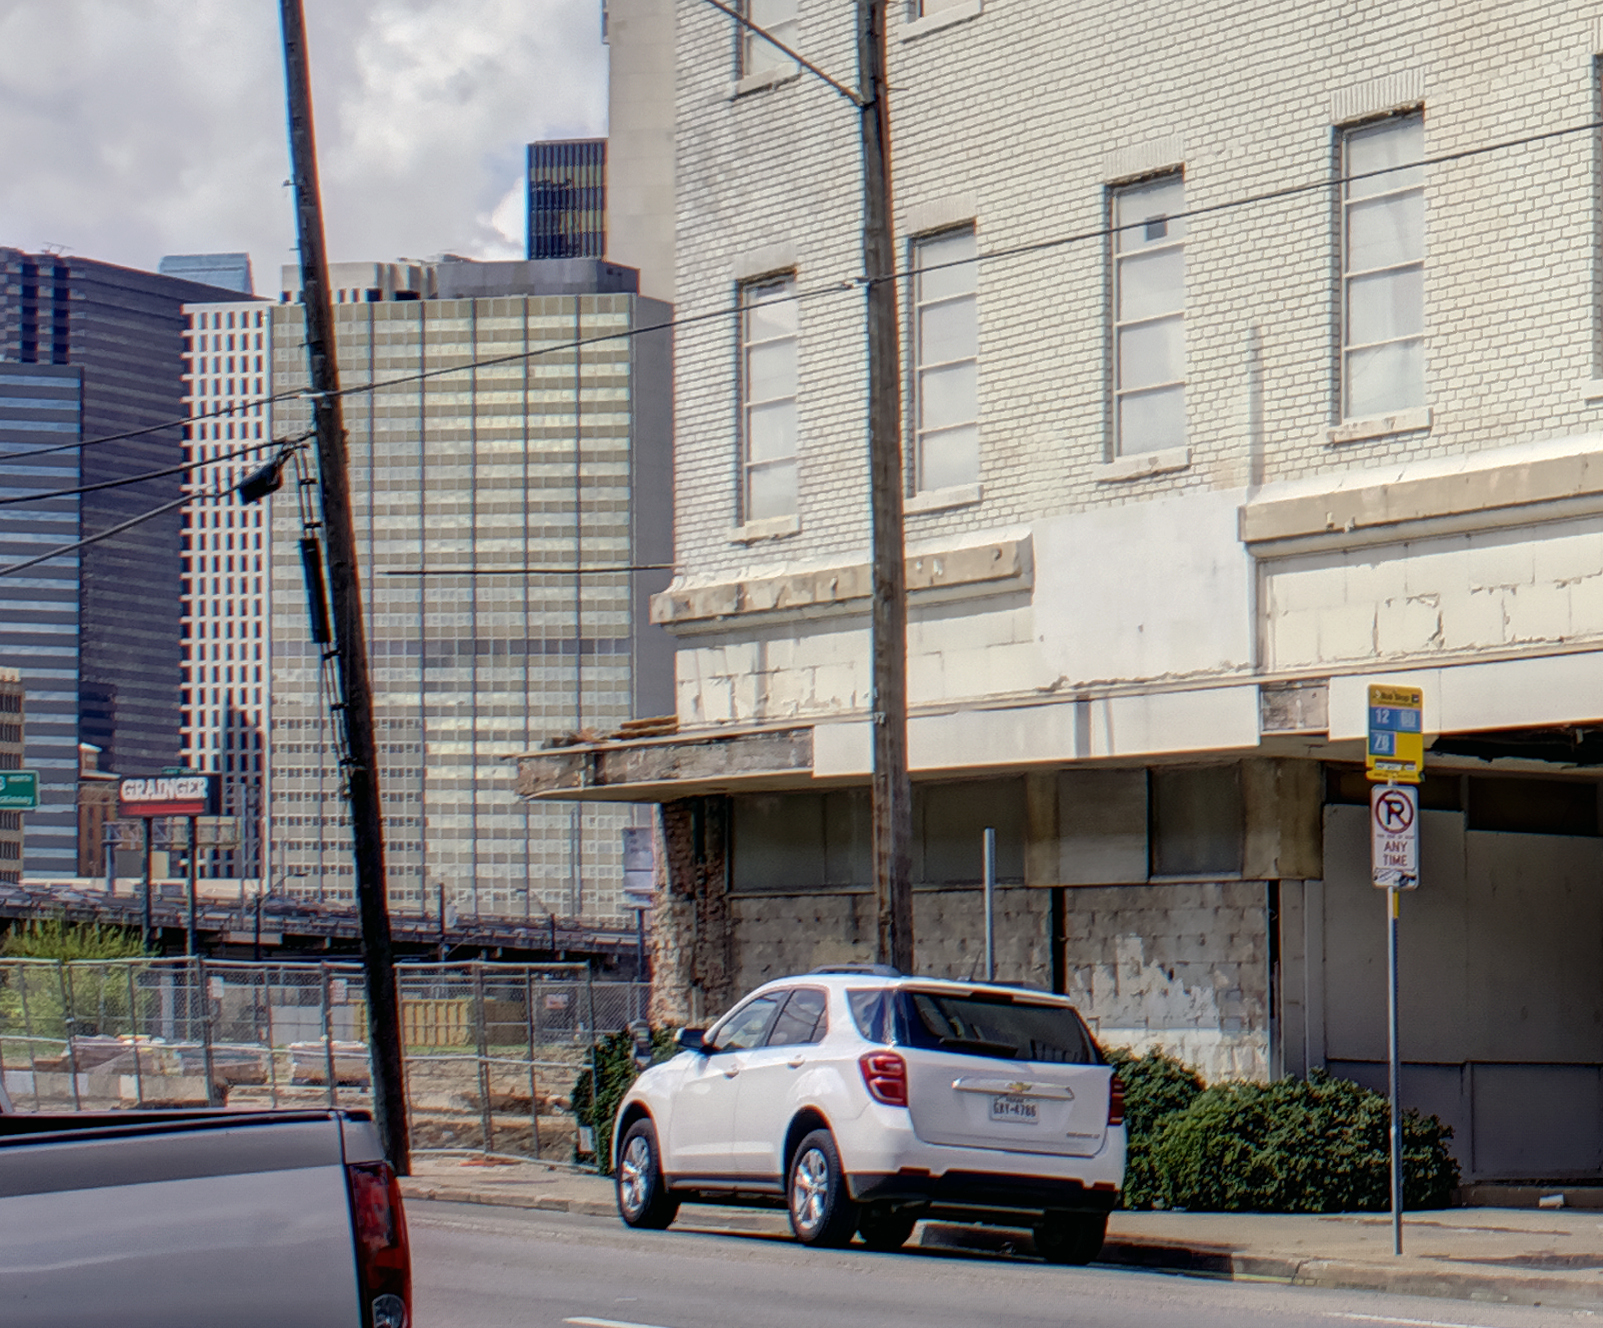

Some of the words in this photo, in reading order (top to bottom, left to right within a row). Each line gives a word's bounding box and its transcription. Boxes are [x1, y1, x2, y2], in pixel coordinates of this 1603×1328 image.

[1375, 707, 1390, 724] 12
[121, 778, 209, 801] GRAINGER
[1383, 840, 1408, 852] ANY
[1383, 854, 1408, 867] TIME
